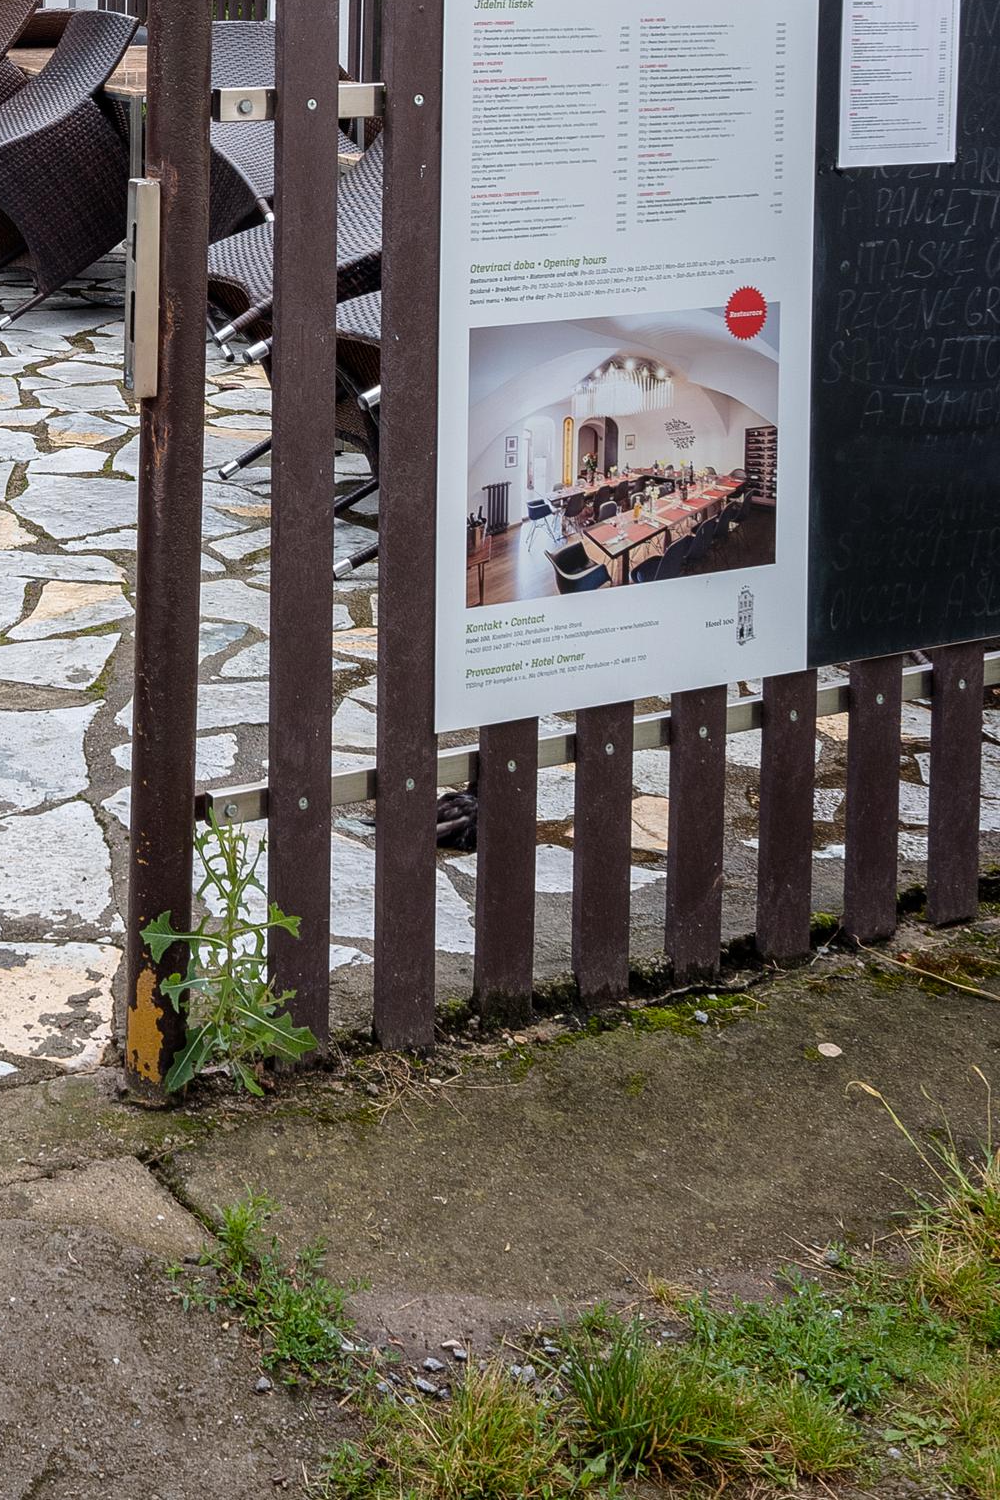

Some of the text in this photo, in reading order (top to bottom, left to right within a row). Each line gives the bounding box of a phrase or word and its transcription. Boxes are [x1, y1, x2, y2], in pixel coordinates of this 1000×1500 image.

[513, 260, 536, 270] doba
[543, 258, 580, 270] Opening
[582, 256, 608, 266] hours
[469, 276, 498, 284] Restaurace
[466, 614, 546, 634] Kontakt Contact
[705, 618, 735, 628] Hotel 100
[466, 652, 586, 679] Provozovatel Hotel Owner
